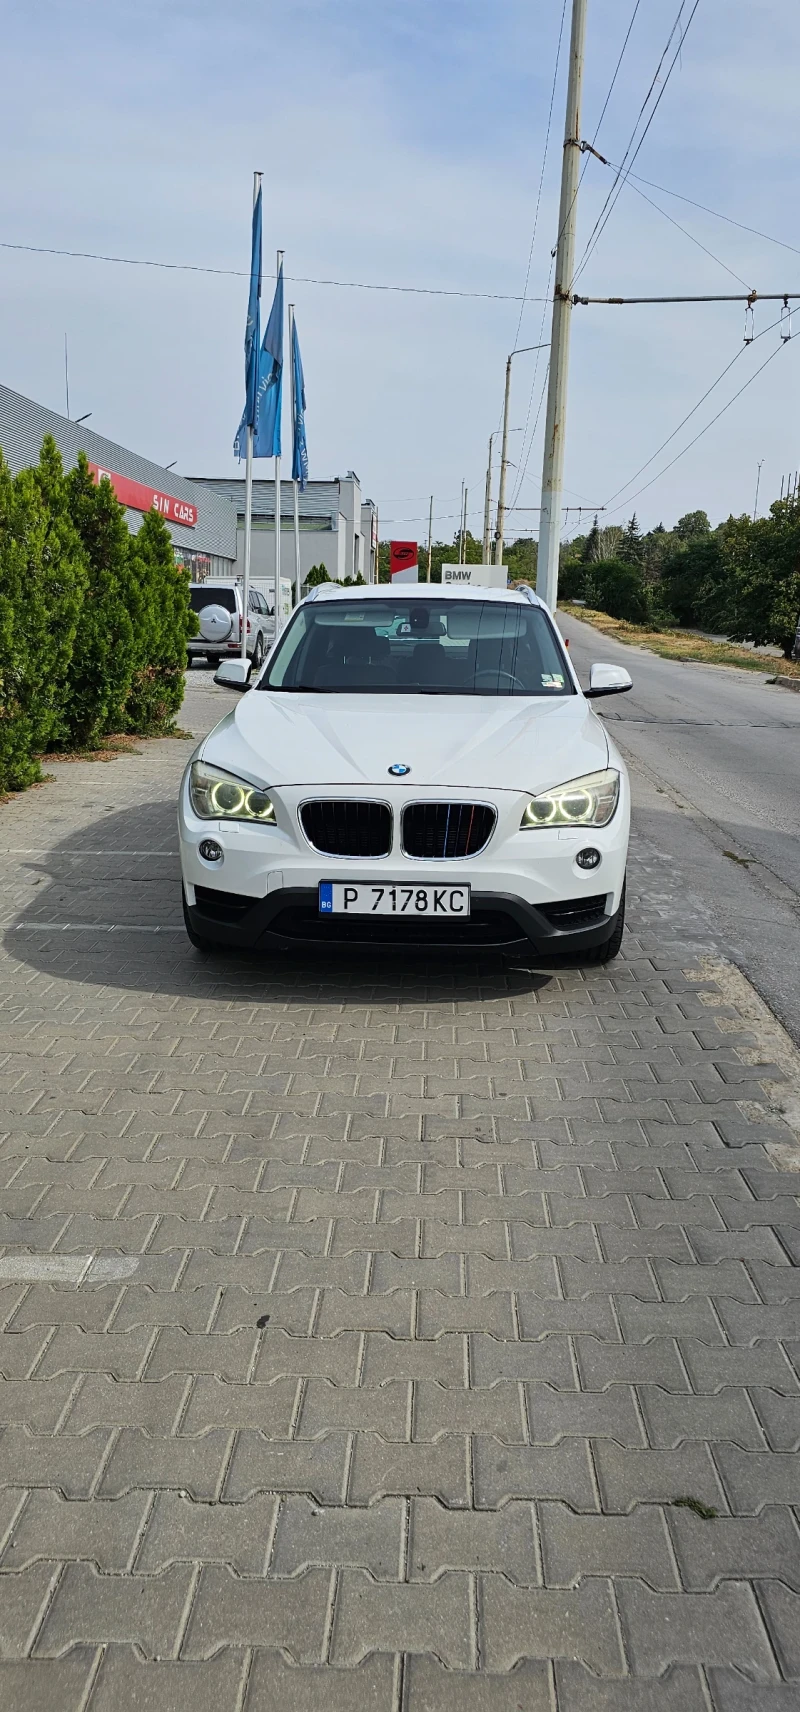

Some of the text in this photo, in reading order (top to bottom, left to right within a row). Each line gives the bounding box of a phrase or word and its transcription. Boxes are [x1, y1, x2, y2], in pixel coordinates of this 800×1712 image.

[152, 494, 194, 523] SIN CARS
[444, 570, 472, 580] BMW
[321, 901, 332, 909] BG
